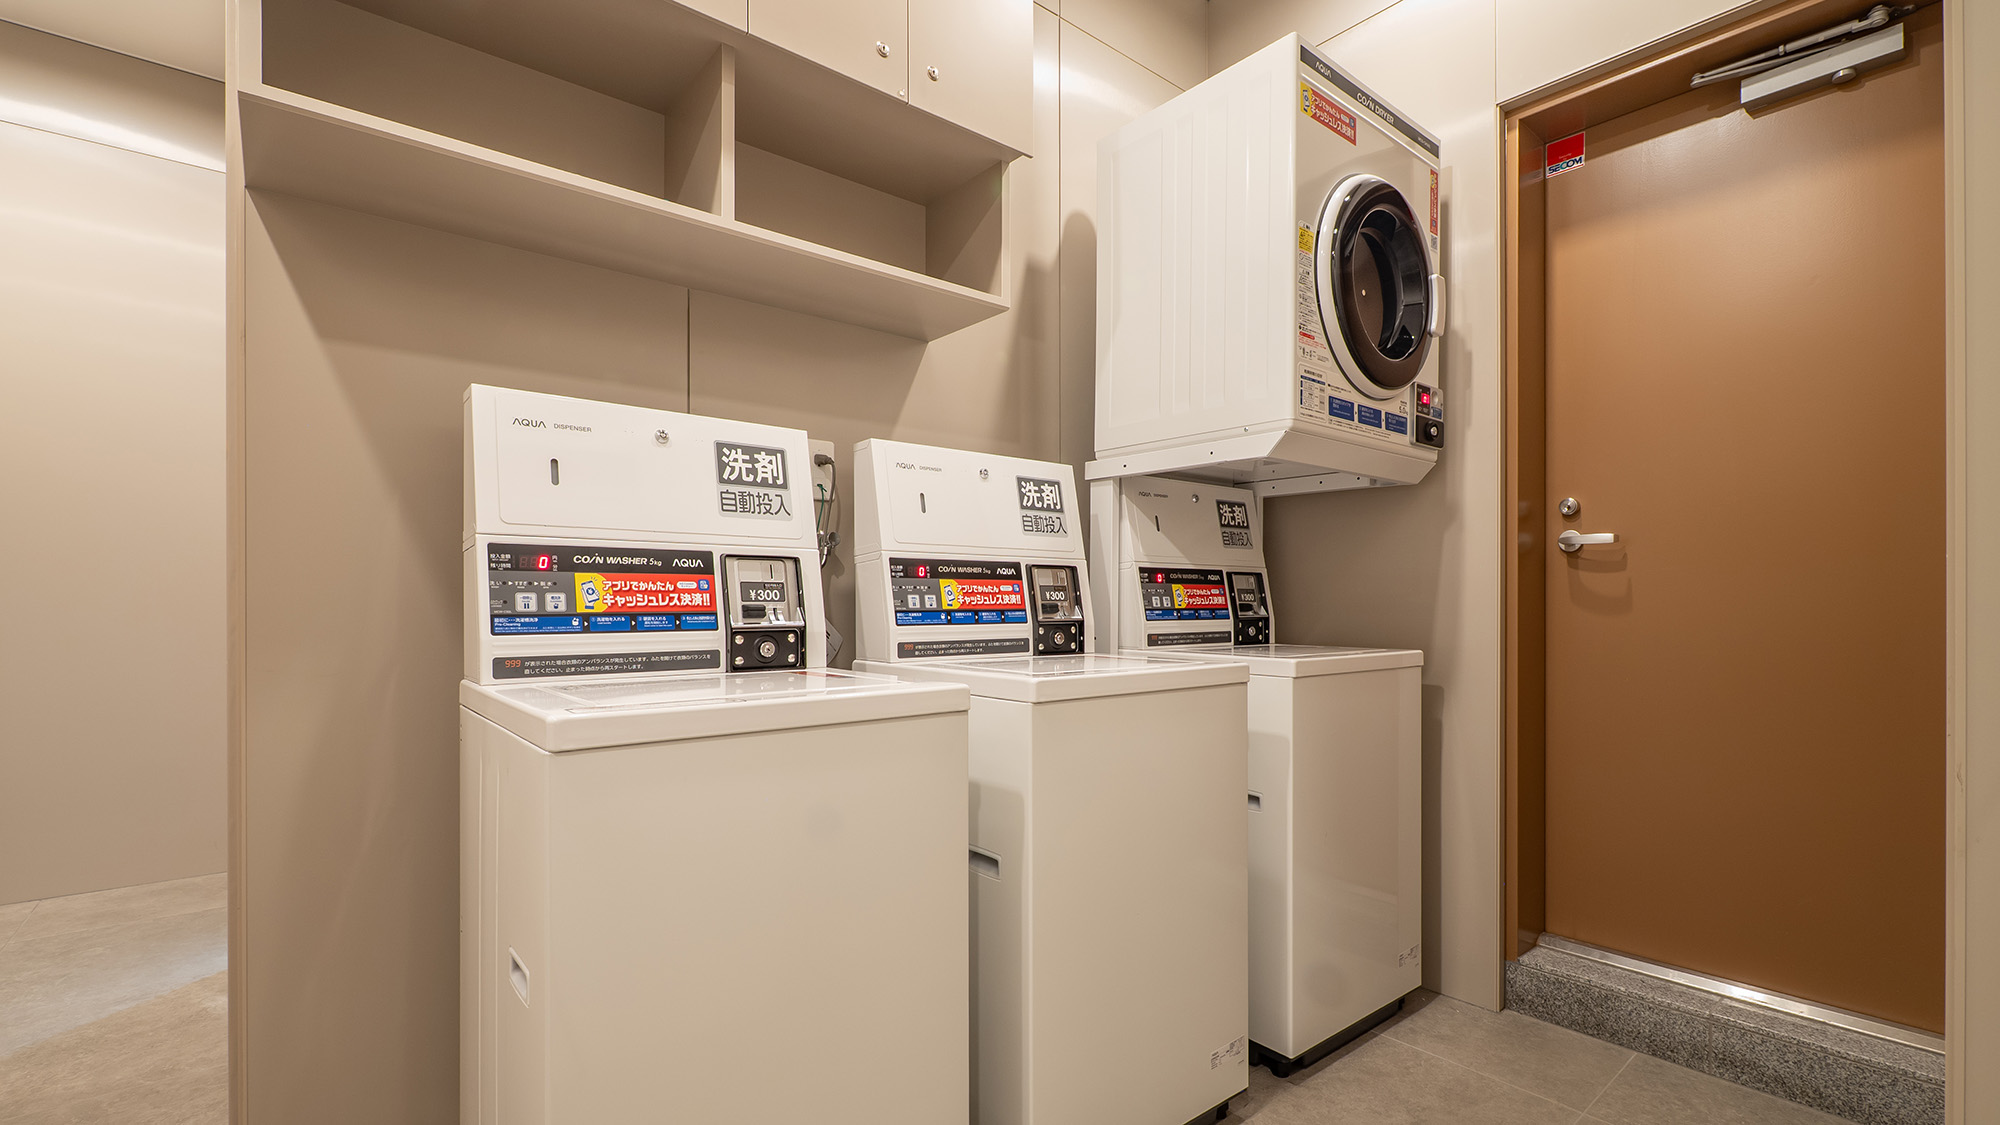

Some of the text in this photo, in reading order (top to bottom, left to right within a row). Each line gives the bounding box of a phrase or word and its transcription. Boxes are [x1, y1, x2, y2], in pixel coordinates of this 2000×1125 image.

[1315, 62, 1332, 78] AQUA
[1375, 105, 1395, 125] DRYER
[1548, 156, 1583, 174] SECOM
[512, 417, 592, 433] AQUA DISPENSER
[721, 447, 784, 485] 洗剤
[895, 462, 916, 470] AQUA
[1020, 481, 1061, 510] 洗剤
[720, 489, 791, 517] 自動投入
[1219, 504, 1247, 527] 洗剤
[1021, 514, 1068, 534] 自動投入
[539, 556, 548, 569] 0
[606, 556, 648, 566] WASHER
[649, 557, 663, 567] 5kg
[672, 558, 704, 568] AQUA
[918, 566, 925, 577] 0
[957, 566, 982, 574] WASHER
[996, 567, 1016, 576] AQUA
[602, 580, 675, 591] アプリでかんたん
[956, 584, 999, 593] アプリでかんたん
[749, 589, 780, 601] ¥300
[1045, 591, 1065, 600] ¥300
[504, 659, 522, 668] 999
